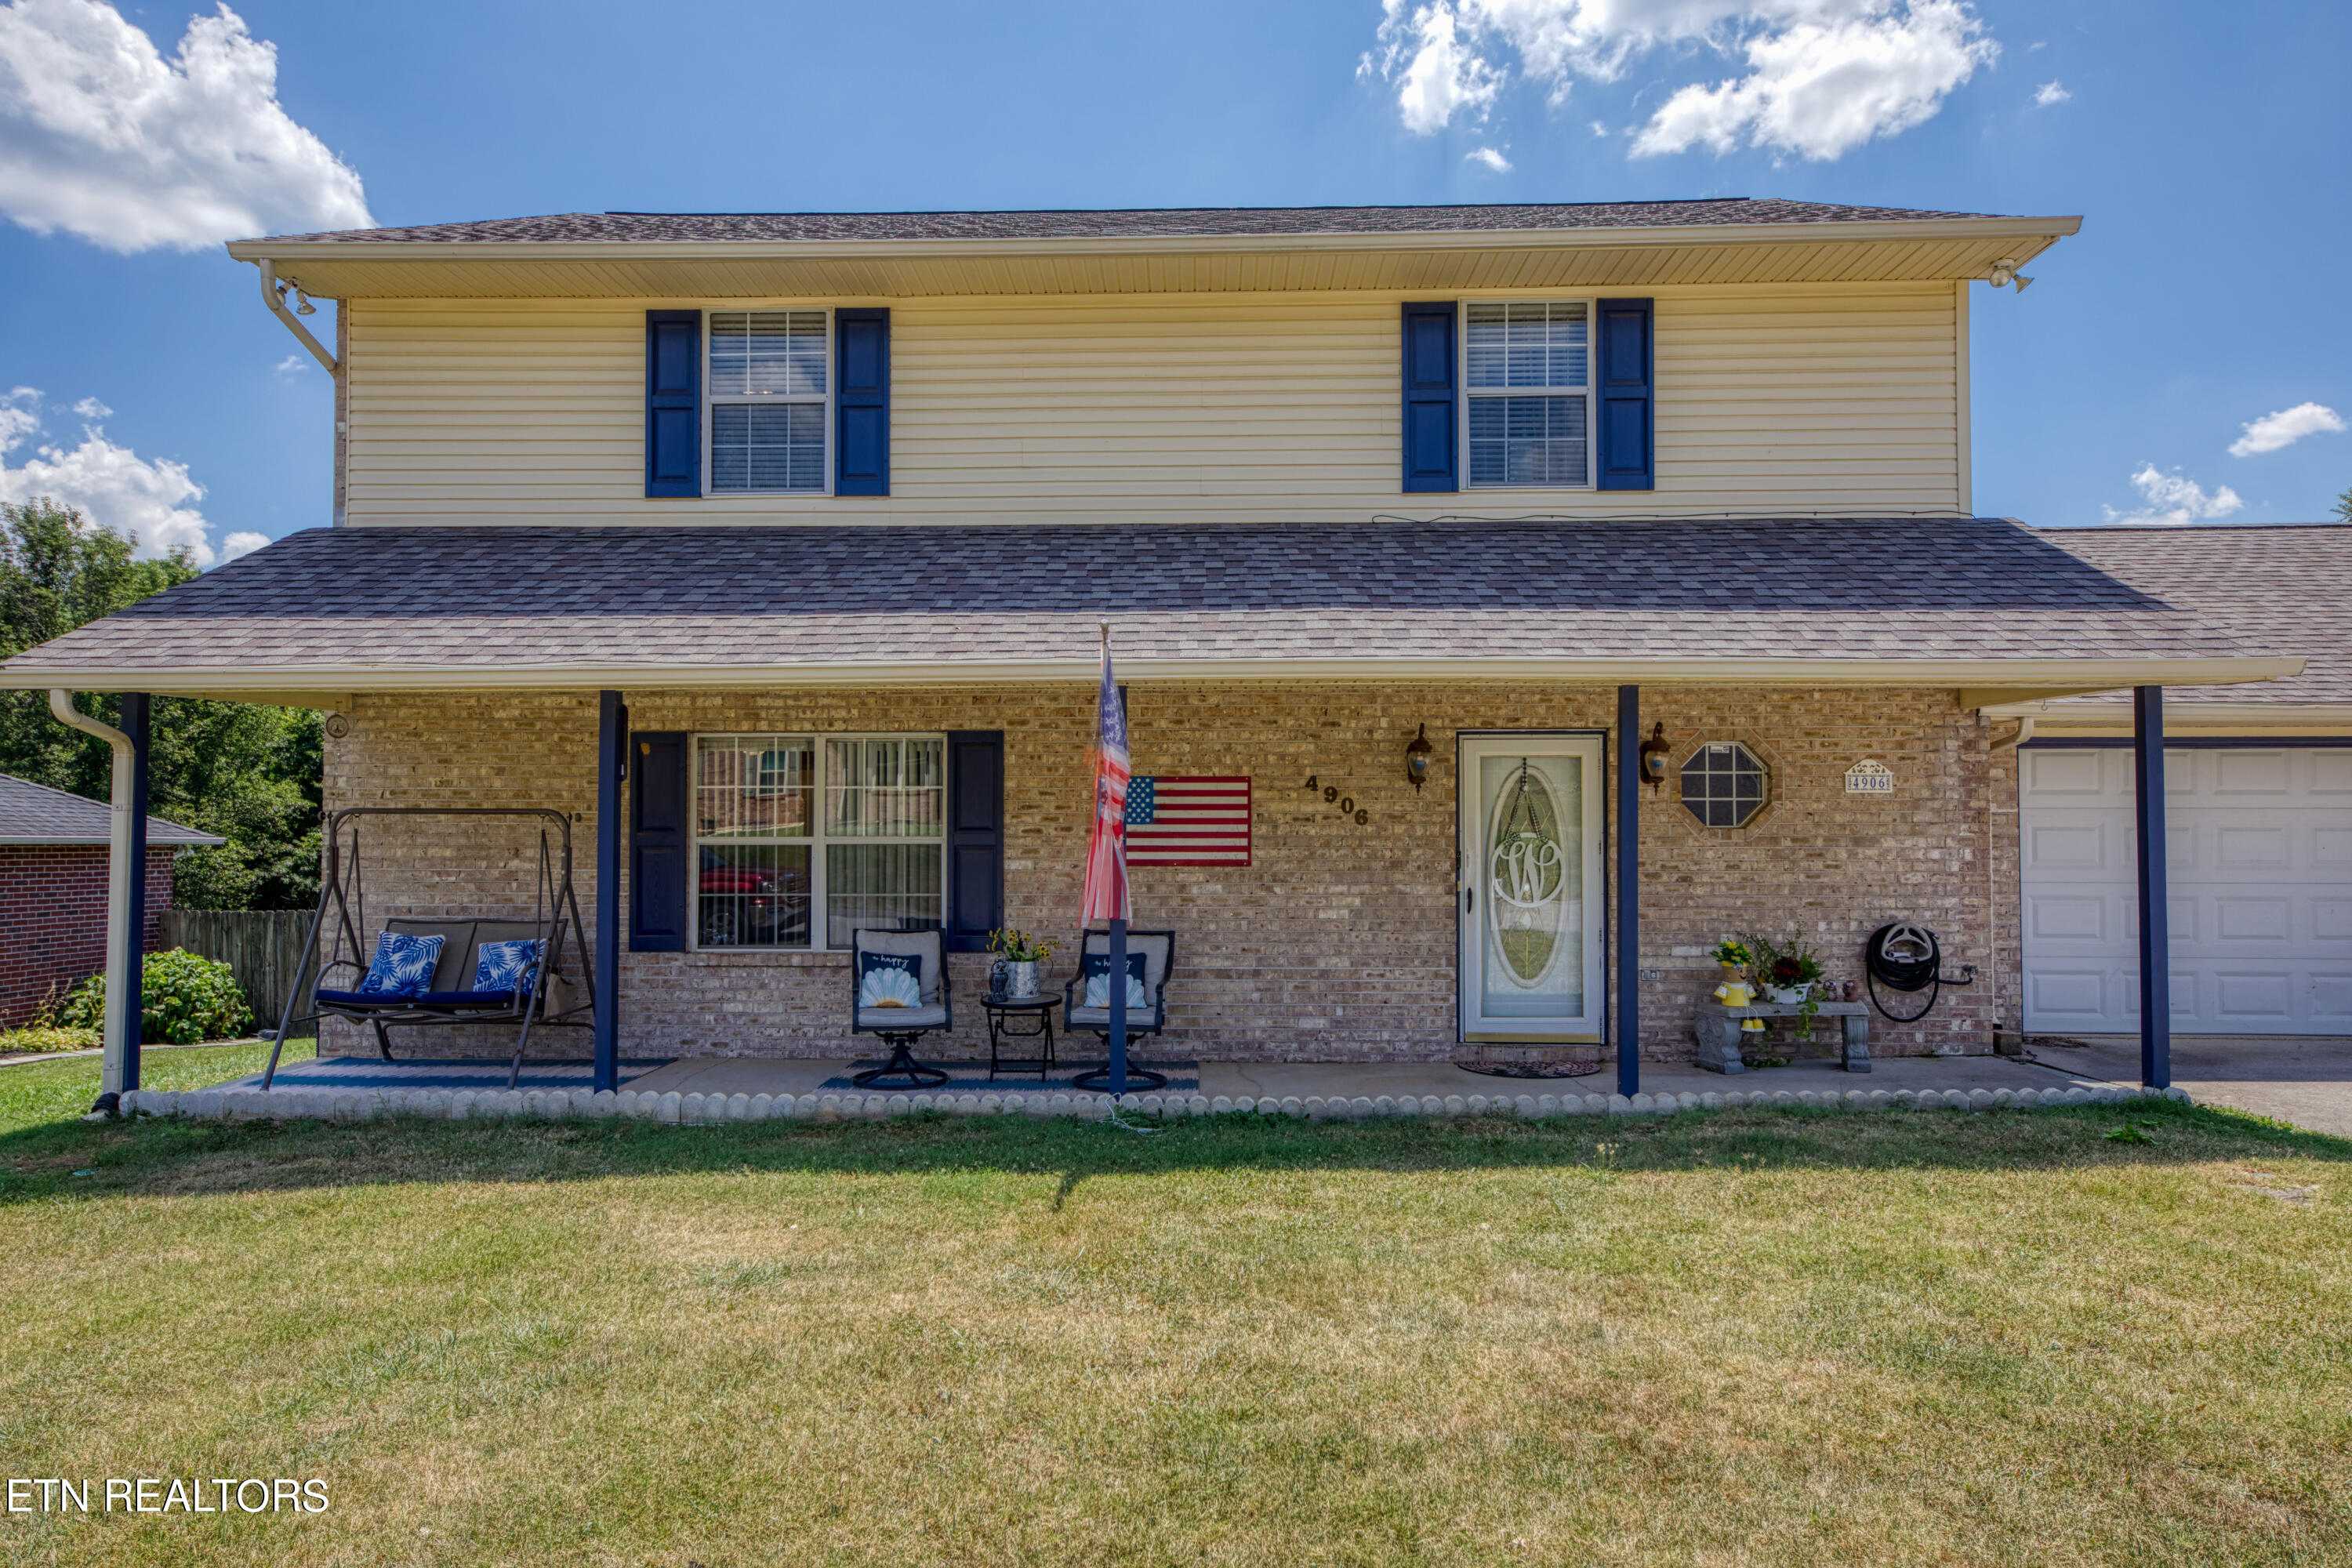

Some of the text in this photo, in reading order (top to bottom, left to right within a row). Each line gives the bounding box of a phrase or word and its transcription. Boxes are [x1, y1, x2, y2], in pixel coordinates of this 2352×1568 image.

[1853, 777, 1885, 789] 4906
[1305, 775, 1368, 826] 4906
[880, 954, 909, 969] happy
